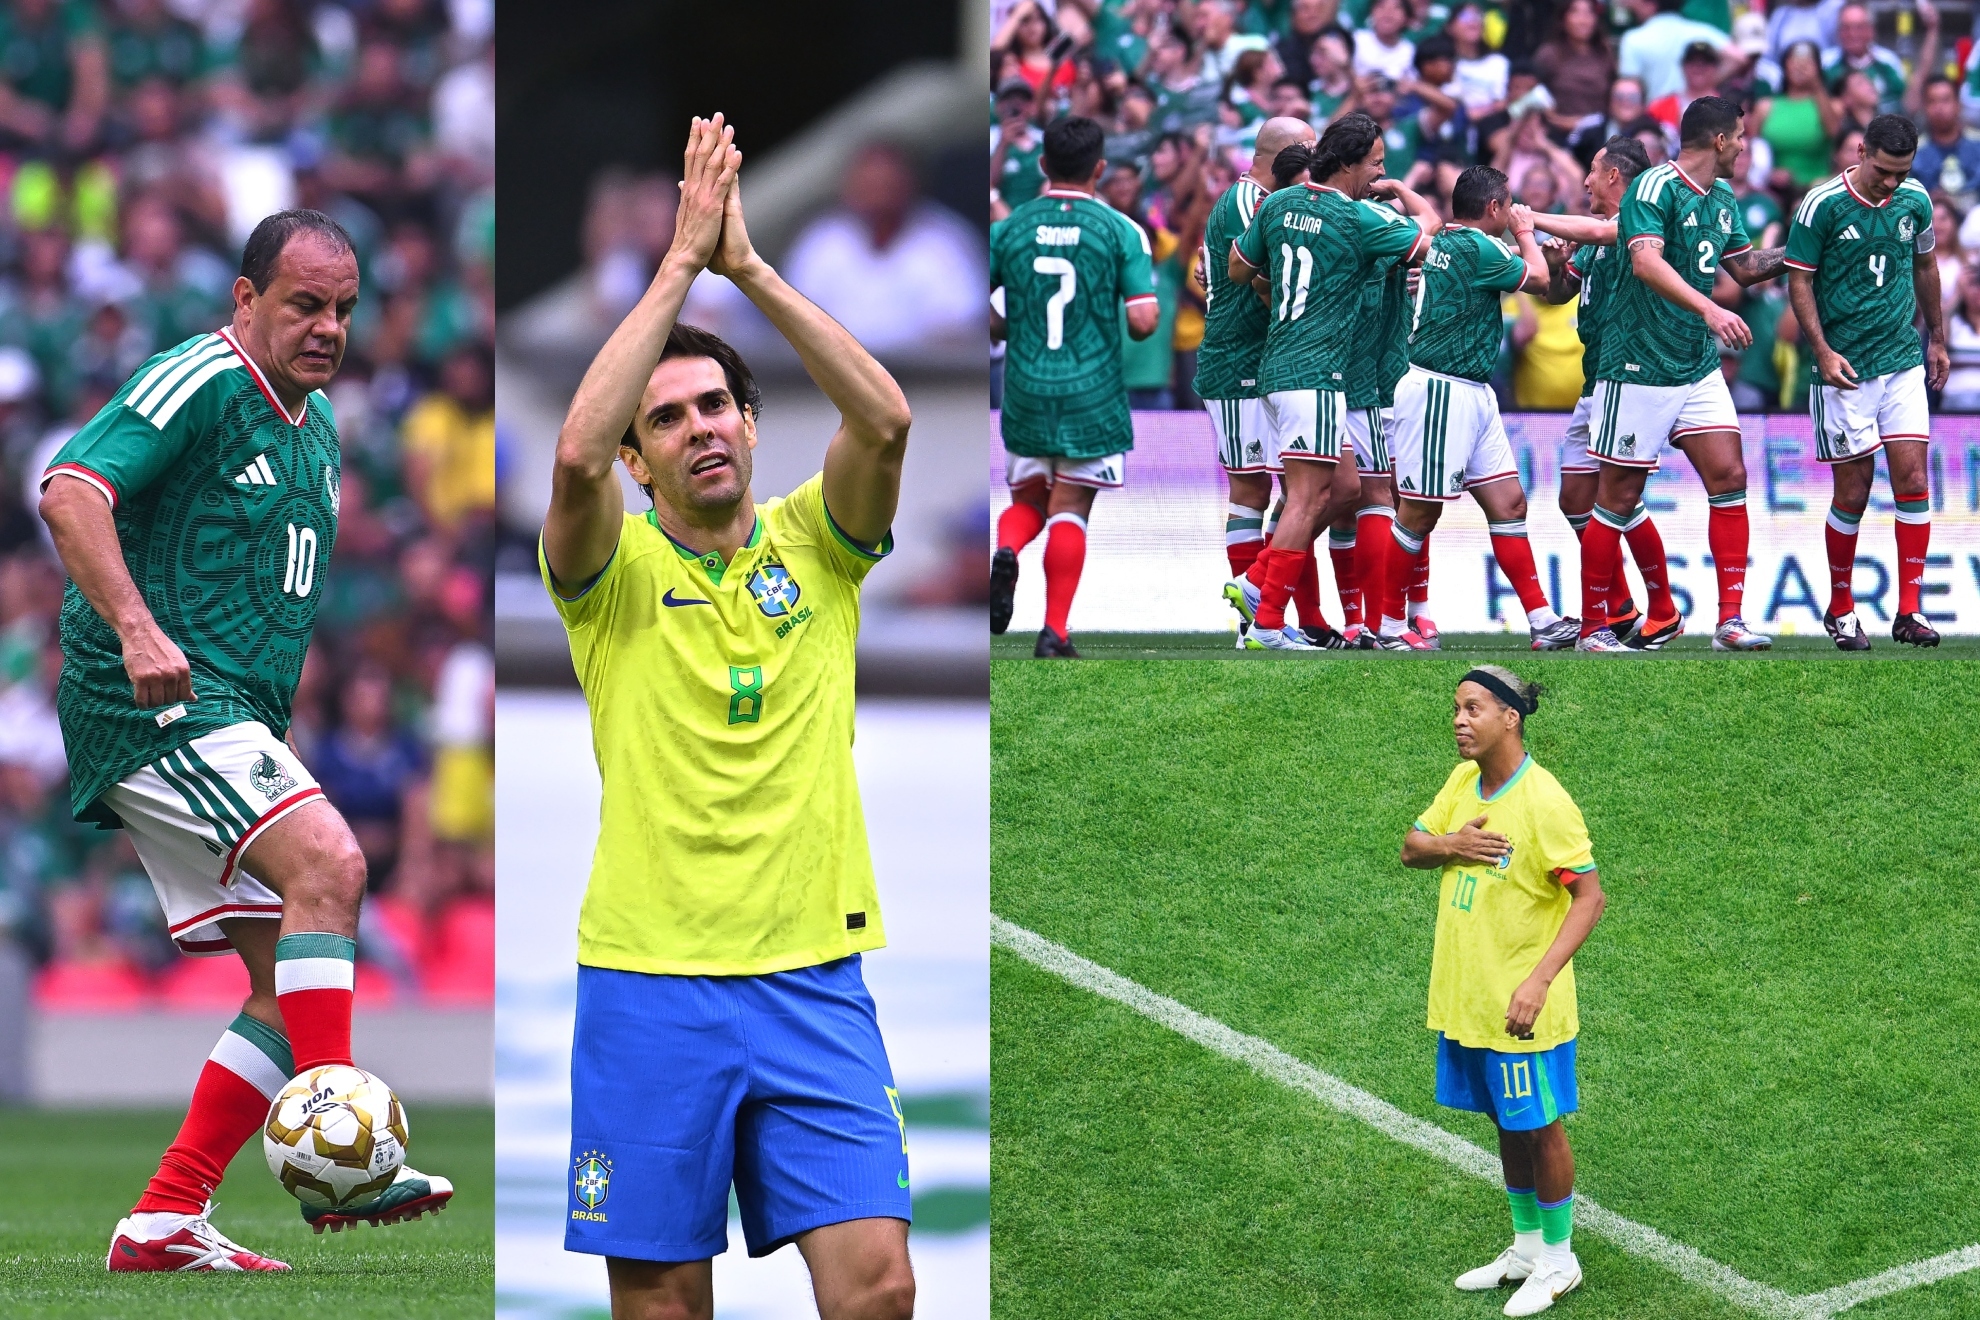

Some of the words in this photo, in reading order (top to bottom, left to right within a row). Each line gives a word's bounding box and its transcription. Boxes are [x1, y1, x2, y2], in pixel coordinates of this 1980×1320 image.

[1283, 211, 1323, 235] B.LUNA
[1698, 240, 1716, 274] 2
[1869, 254, 1887, 288] 4
[1279, 242, 1314, 321] 11
[1033, 255, 1077, 351] 7
[283, 522, 317, 598] 10
[766, 582, 785, 597] CBF
[774, 605, 814, 640] BRASIL
[728, 665, 763, 726] 8
[1485, 868, 1508, 881] BRASIL
[1451, 870, 1478, 914] 10
[1500, 1059, 1532, 1099] 10
[585, 1178, 600, 1186] CBF
[571, 1210, 609, 1223] BRASIL
